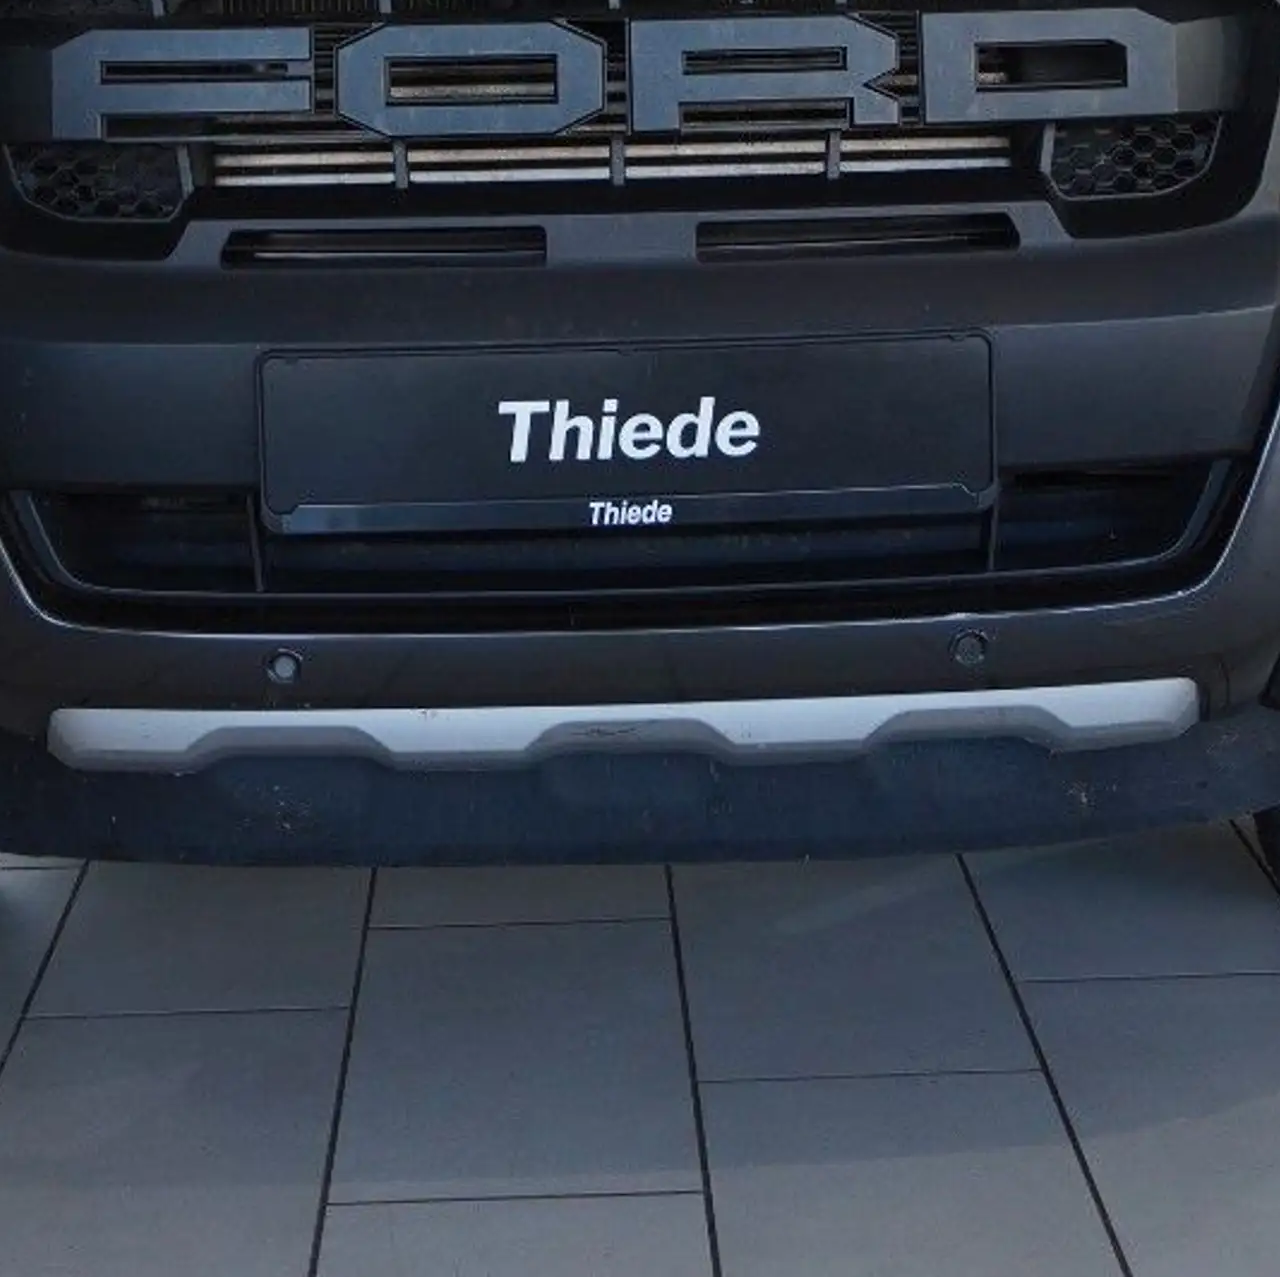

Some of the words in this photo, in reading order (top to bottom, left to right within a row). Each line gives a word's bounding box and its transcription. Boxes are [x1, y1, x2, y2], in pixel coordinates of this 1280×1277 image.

[51, 7, 1178, 137] FORD
[497, 395, 762, 463] Thiede
[588, 499, 673, 526] Thiede
